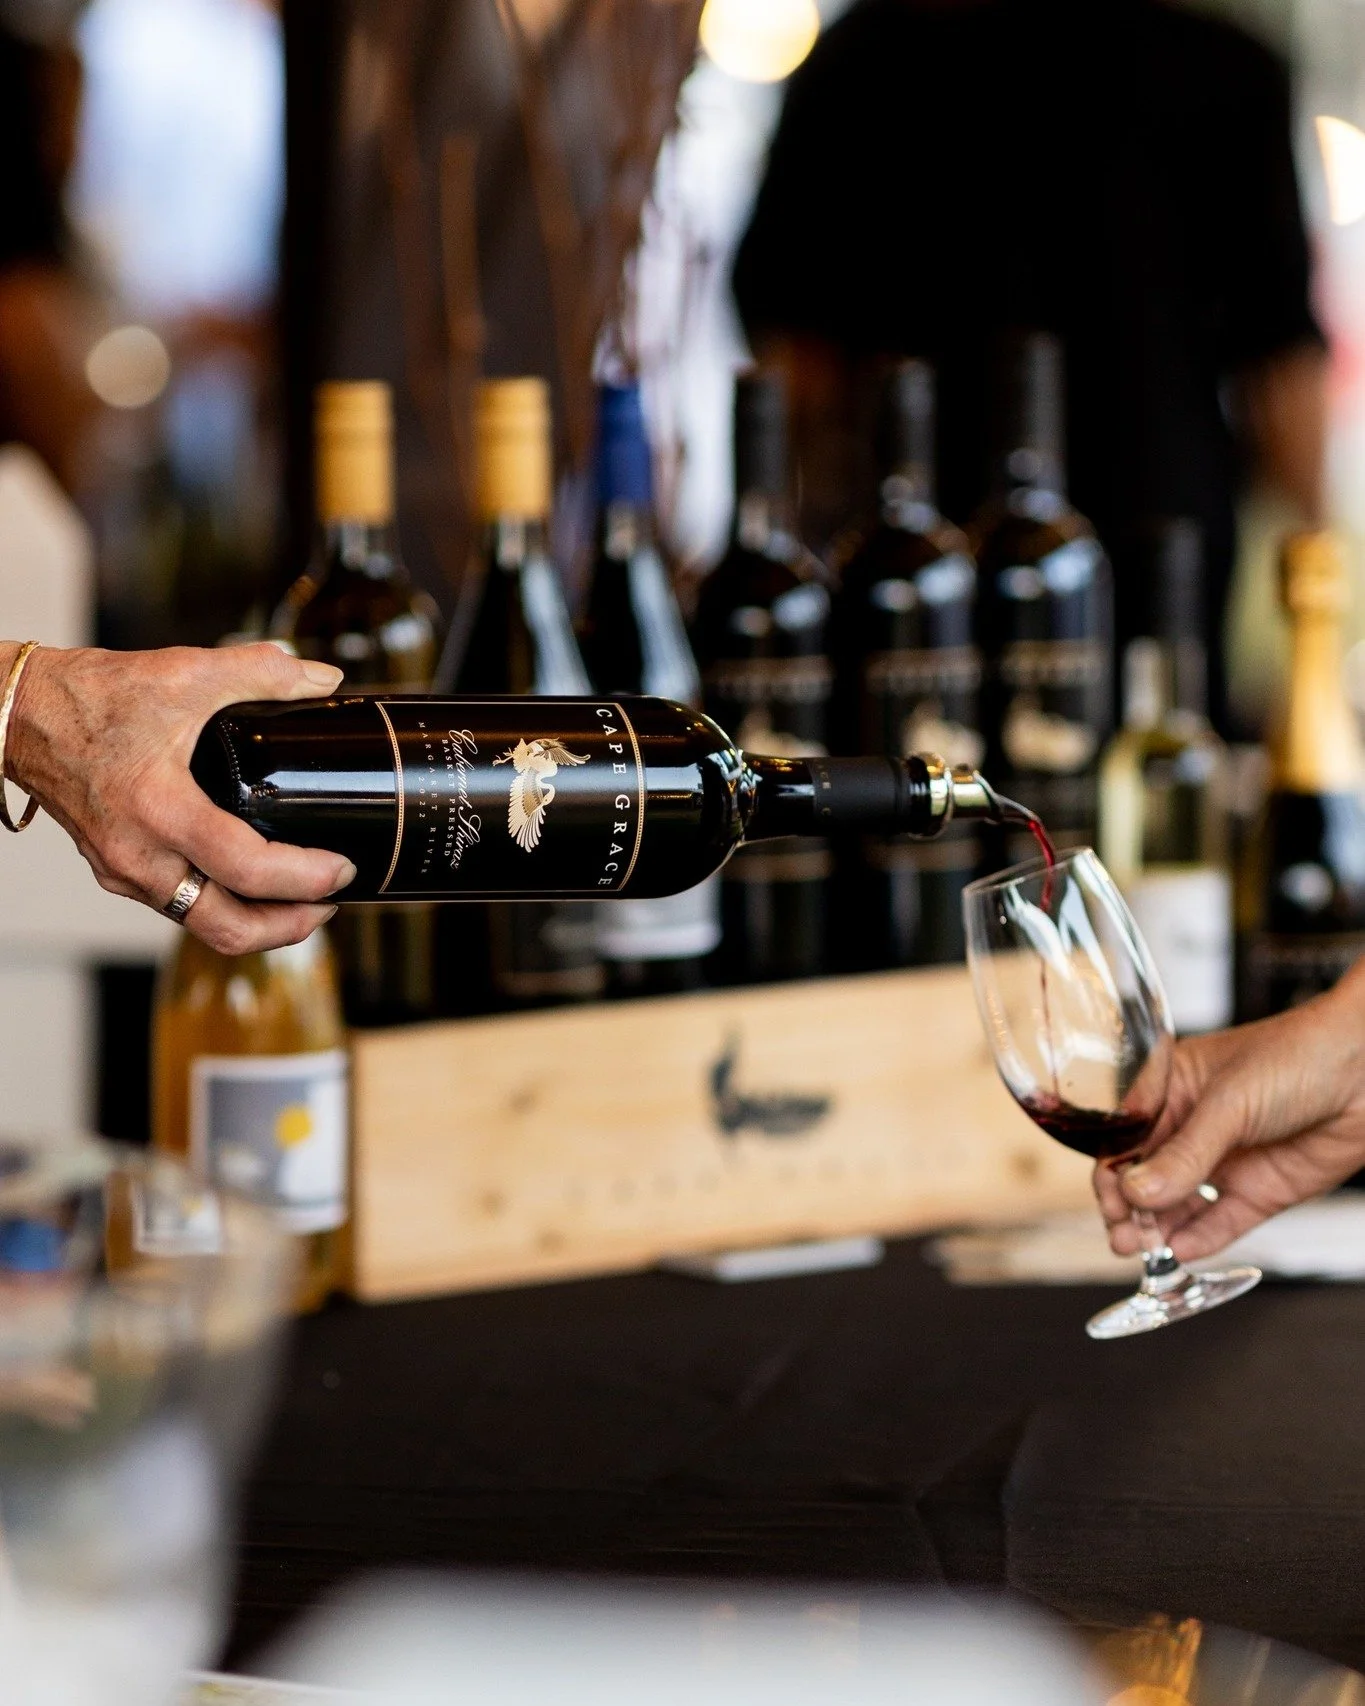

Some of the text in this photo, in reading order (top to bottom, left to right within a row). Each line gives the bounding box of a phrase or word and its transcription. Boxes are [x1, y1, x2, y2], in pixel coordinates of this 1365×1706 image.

[418, 776, 426, 818] 2022
[418, 721, 438, 874] MARGARET RIVER
[442, 739, 456, 856] BASKET PRESSED
[449, 729, 482, 869] Cabernet Shiraz
[596, 708, 630, 885] CAPE GRACE
